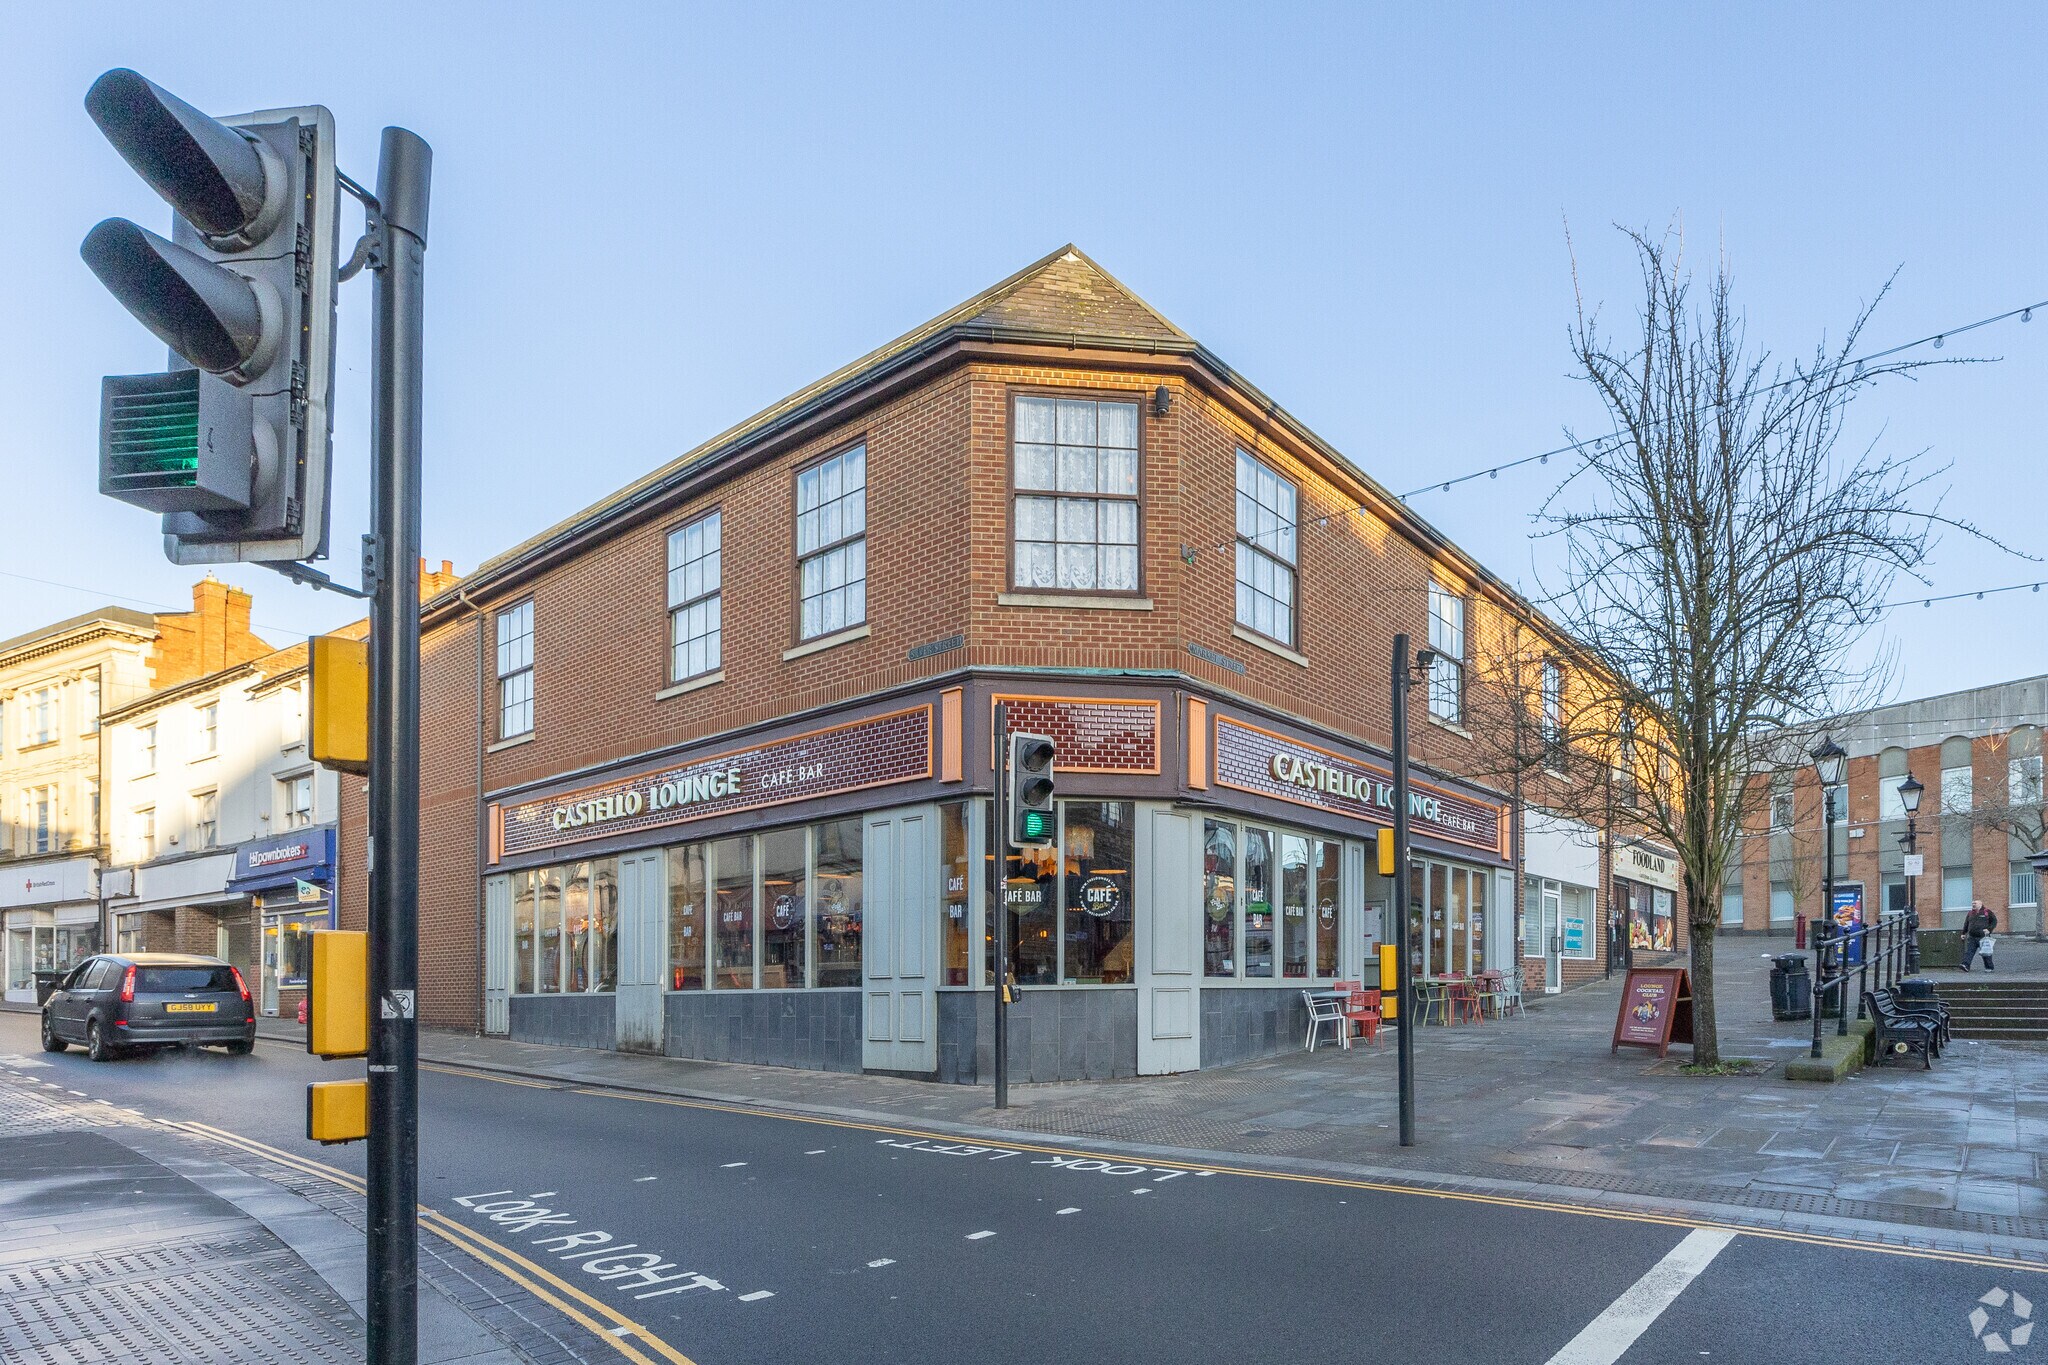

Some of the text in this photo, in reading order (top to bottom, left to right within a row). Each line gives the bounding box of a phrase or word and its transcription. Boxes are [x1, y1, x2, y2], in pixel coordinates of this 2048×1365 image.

[934, 636, 963, 652] STREET
[1189, 643, 1244, 673] MARKET STREET
[552, 763, 824, 831] CASTELLO LOUNGE CAFÉ BAR
[1271, 752, 1476, 832] CASTELLO LNGE CAFÉ BAR
[258, 845, 301, 864] pawnbrokers
[1632, 849, 1665, 873] FOODLAND
[948, 875, 964, 891] CAFÉ
[1007, 888, 1042, 903] AFÉ BAR
[1087, 885, 1112, 902] CAFÉ
[1252, 888, 1264, 902] CAFÉ
[776, 902, 790, 917] CAFÉ
[949, 904, 963, 918] BAR
[1285, 905, 1304, 917] CAFÉ BAR
[1322, 905, 1333, 919] CAFÉ
[888, 1140, 1189, 1182] LOOK LEFT
[451, 1190, 728, 1300] LOOK RIGHT
